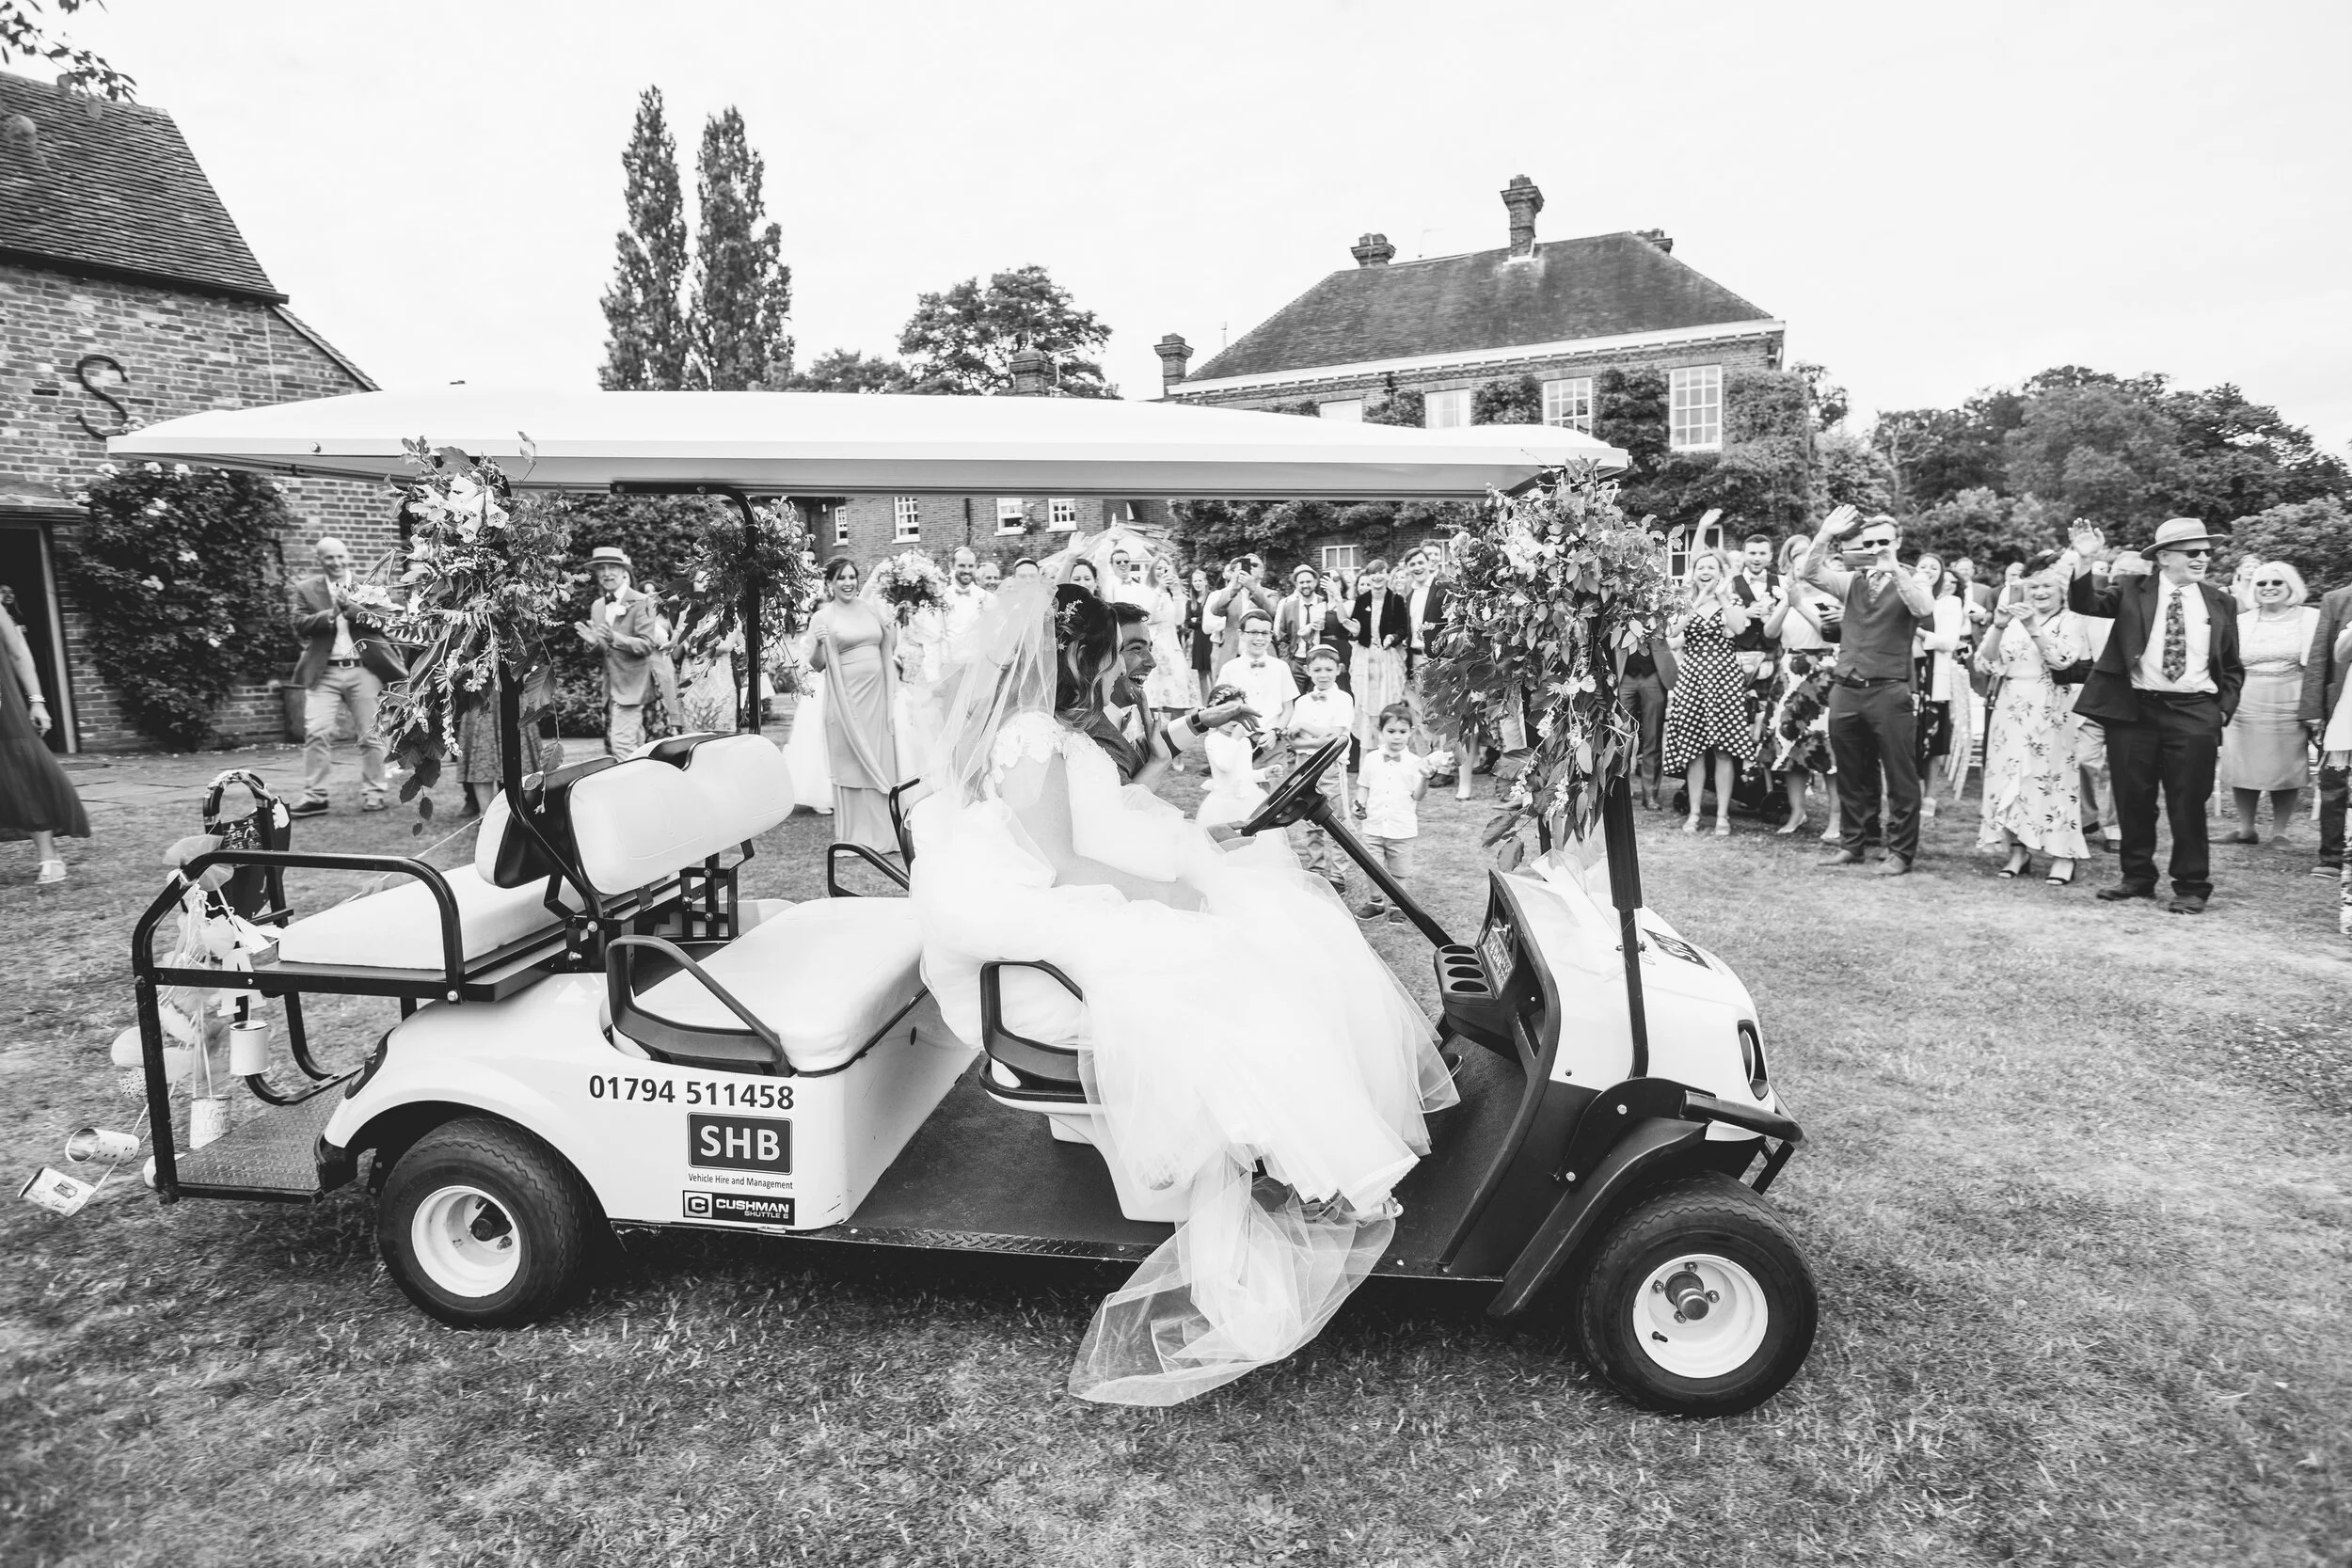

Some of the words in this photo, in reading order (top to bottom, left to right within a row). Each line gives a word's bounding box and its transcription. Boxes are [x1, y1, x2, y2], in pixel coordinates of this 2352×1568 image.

[589, 1075, 675, 1102] 01794
[687, 1081, 794, 1110] 511458
[700, 1125, 780, 1161] SHB
[689, 1173, 713, 1183] Vehicle
[716, 1175, 729, 1185] Hire
[732, 1176, 744, 1186] and
[747, 1178, 793, 1190] Management
[716, 1198, 789, 1212] CUSHMAN
[744, 1211, 781, 1219] SHUTTLE
